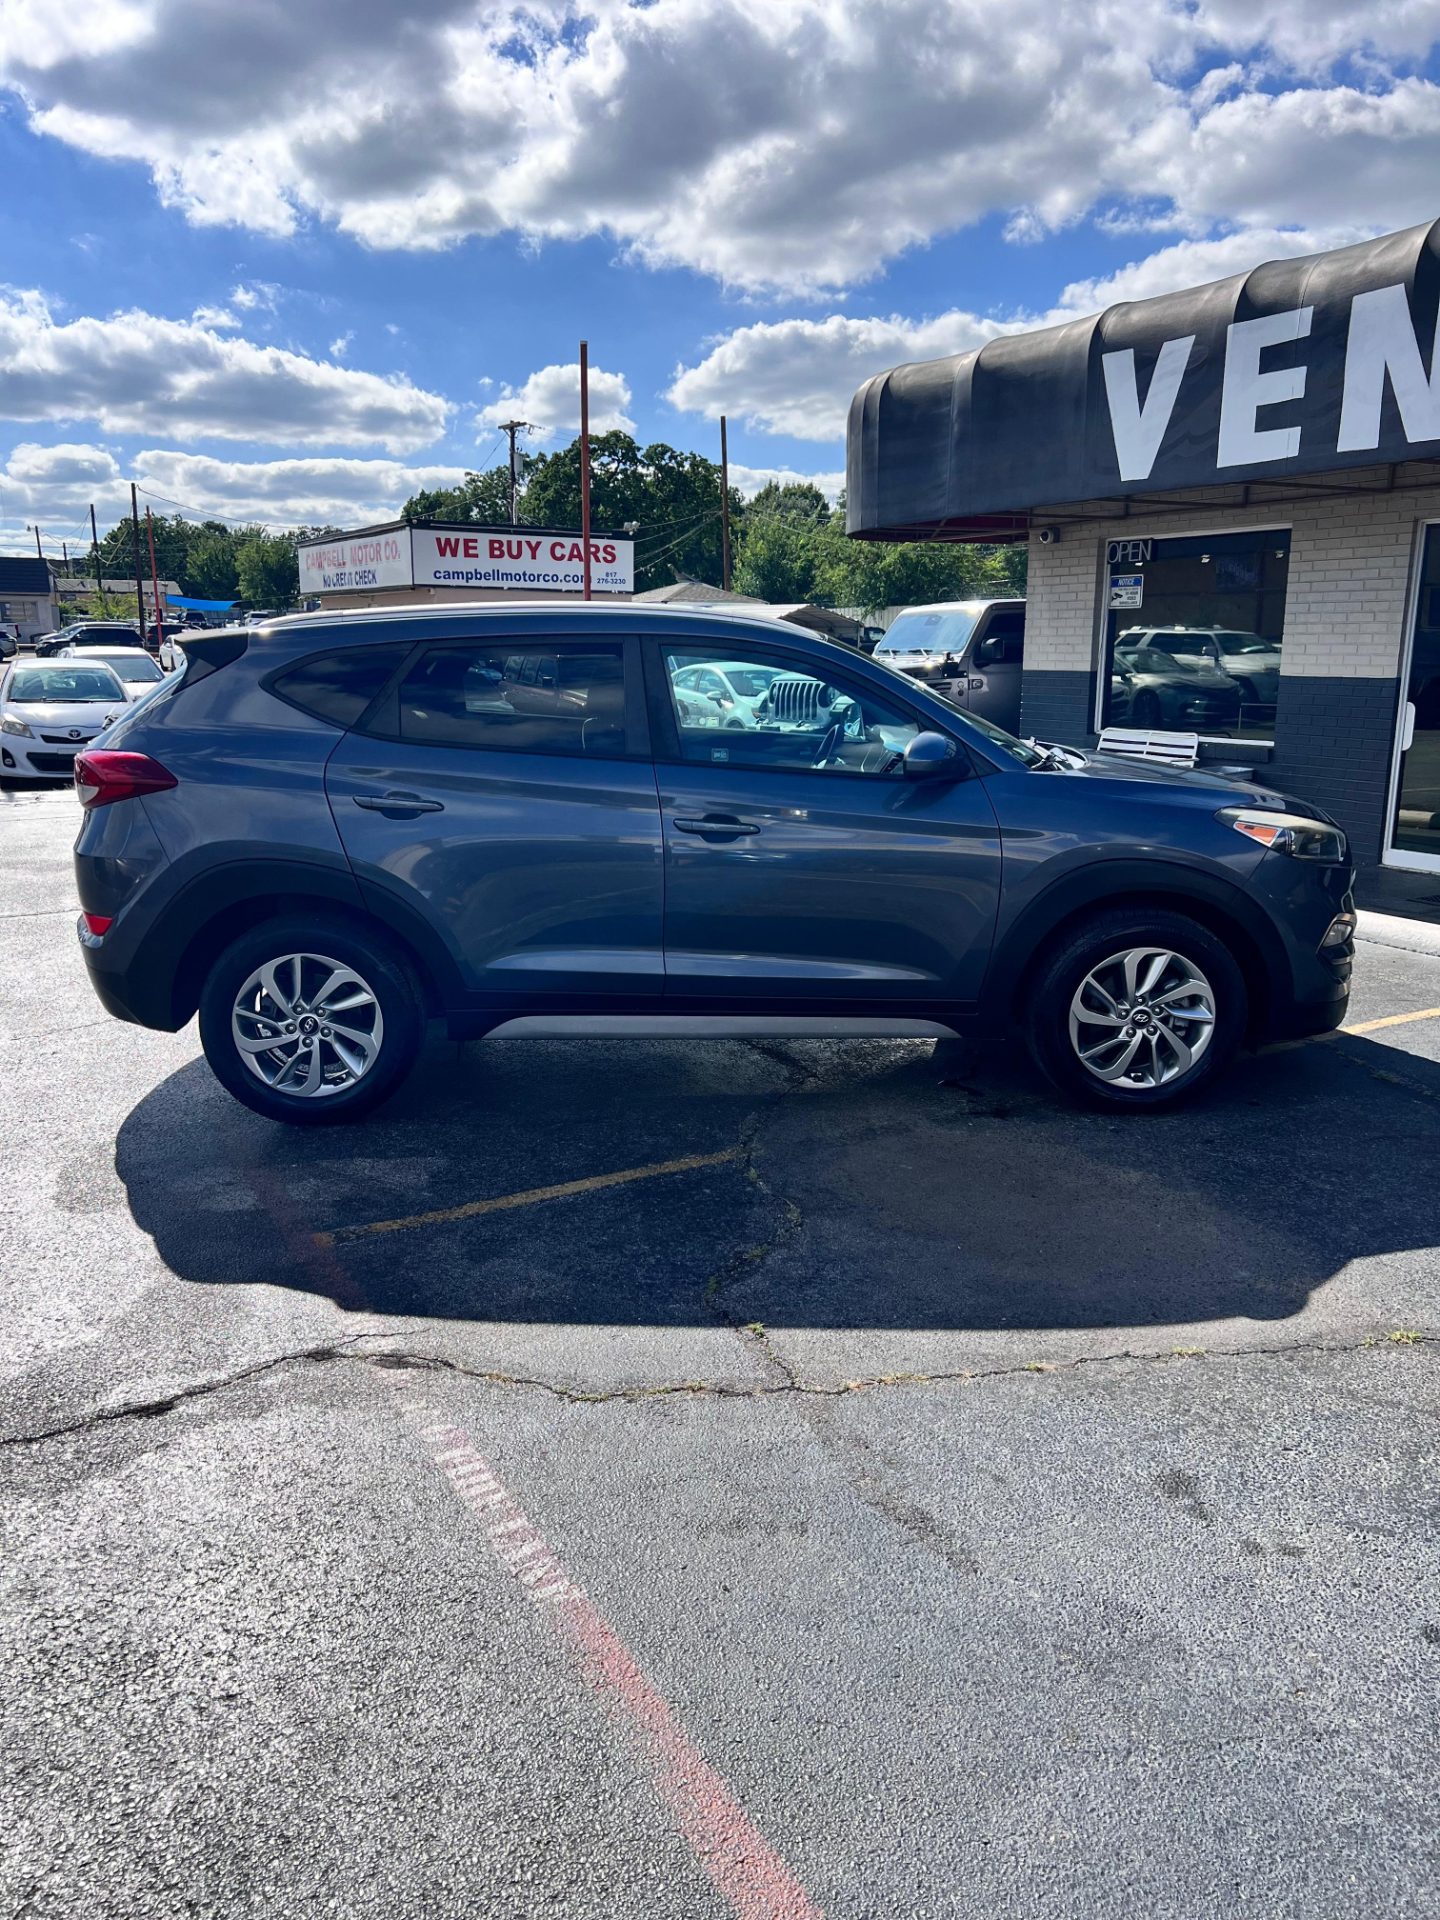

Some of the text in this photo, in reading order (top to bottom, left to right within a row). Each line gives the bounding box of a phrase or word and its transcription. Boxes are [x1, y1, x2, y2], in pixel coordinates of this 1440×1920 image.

[306, 540, 401, 570] CAMPBELL MOTOR CO.
[435, 537, 617, 564] WE BUY CARS
[1107, 540, 1152, 563] OPEN
[322, 574, 331, 588] NO
[354, 569, 377, 585] CHECK
